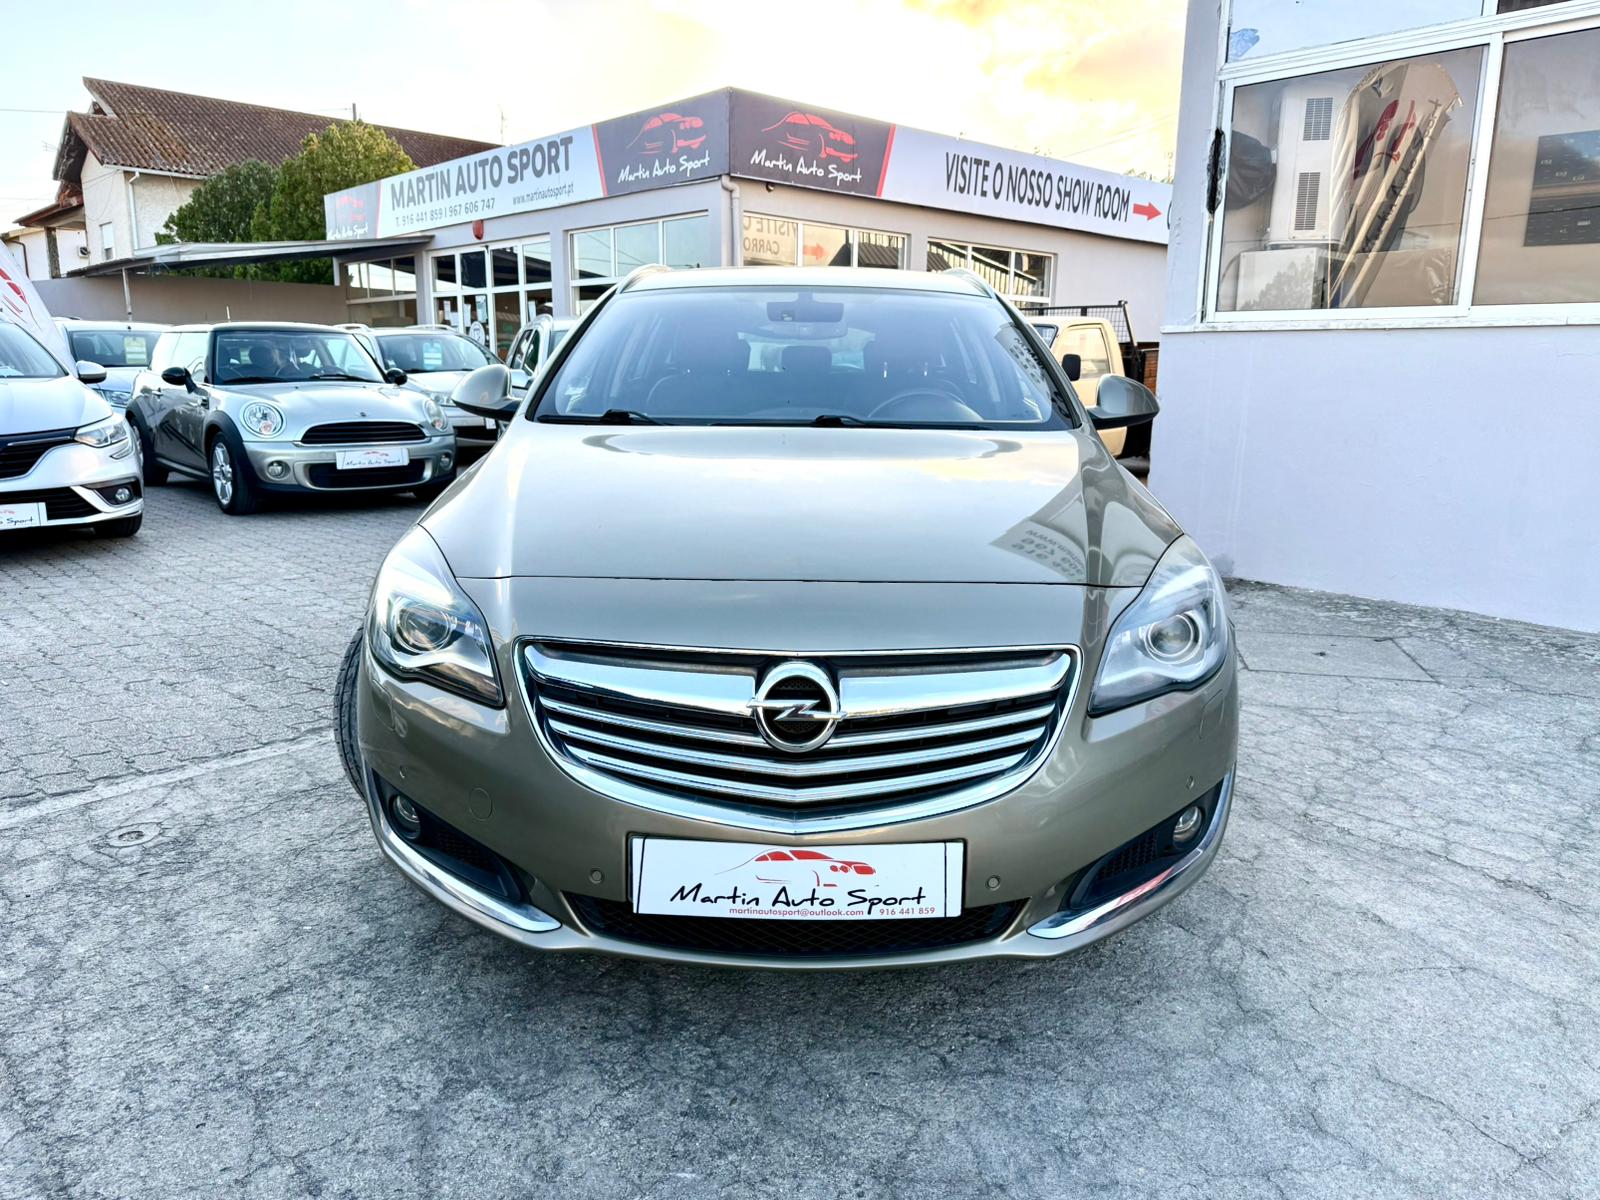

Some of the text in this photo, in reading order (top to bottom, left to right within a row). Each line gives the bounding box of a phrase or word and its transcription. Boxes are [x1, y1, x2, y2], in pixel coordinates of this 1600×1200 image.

[391, 135, 573, 211] MARTIN AUTO SPORT
[617, 149, 711, 184] Martin Auto Sport
[750, 148, 862, 187] Martin Auto Sport
[945, 151, 990, 198] VISITE
[992, 162, 1004, 200] O
[1006, 164, 1053, 209] NOSSO
[1055, 174, 1095, 213] SHOW
[1094, 183, 1131, 223] ROOM
[402, 213, 414, 226] 916
[415, 211, 427, 222] 441
[430, 207, 443, 221] 859
[449, 203, 462, 217] 967
[464, 200, 479, 215] 606
[481, 197, 496, 212] 747
[6, 515, 34, 526] Sport
[669, 883, 927, 915] Martin Auto Sport
[729, 907, 865, 917] martinautosport@outlook.com
[879, 908, 896, 916] 916
[918, 906, 936, 915] 859
